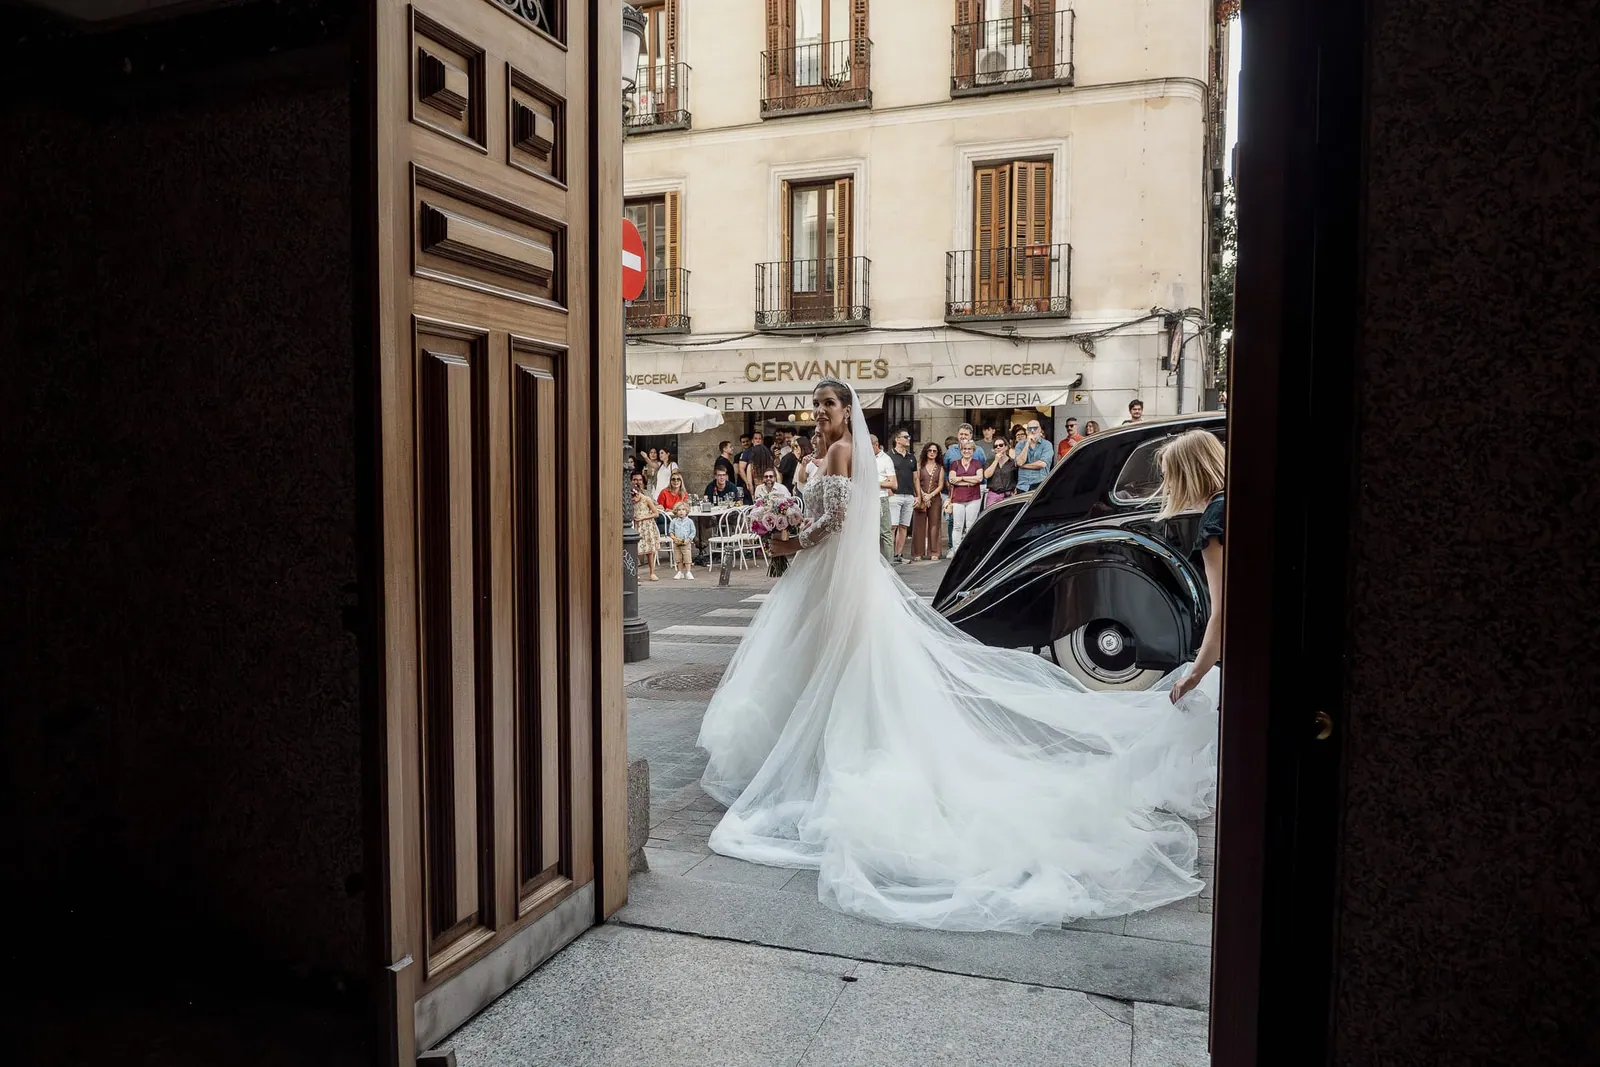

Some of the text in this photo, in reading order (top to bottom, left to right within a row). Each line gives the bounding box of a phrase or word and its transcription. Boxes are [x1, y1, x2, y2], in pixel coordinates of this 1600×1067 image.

[745, 358, 889, 382] CERVANTES
[964, 363, 1055, 376] CERVECERIA
[626, 373, 679, 385] VECERIA
[706, 396, 806, 411] CERVAN
[942, 393, 1042, 407] CERVECERIA
